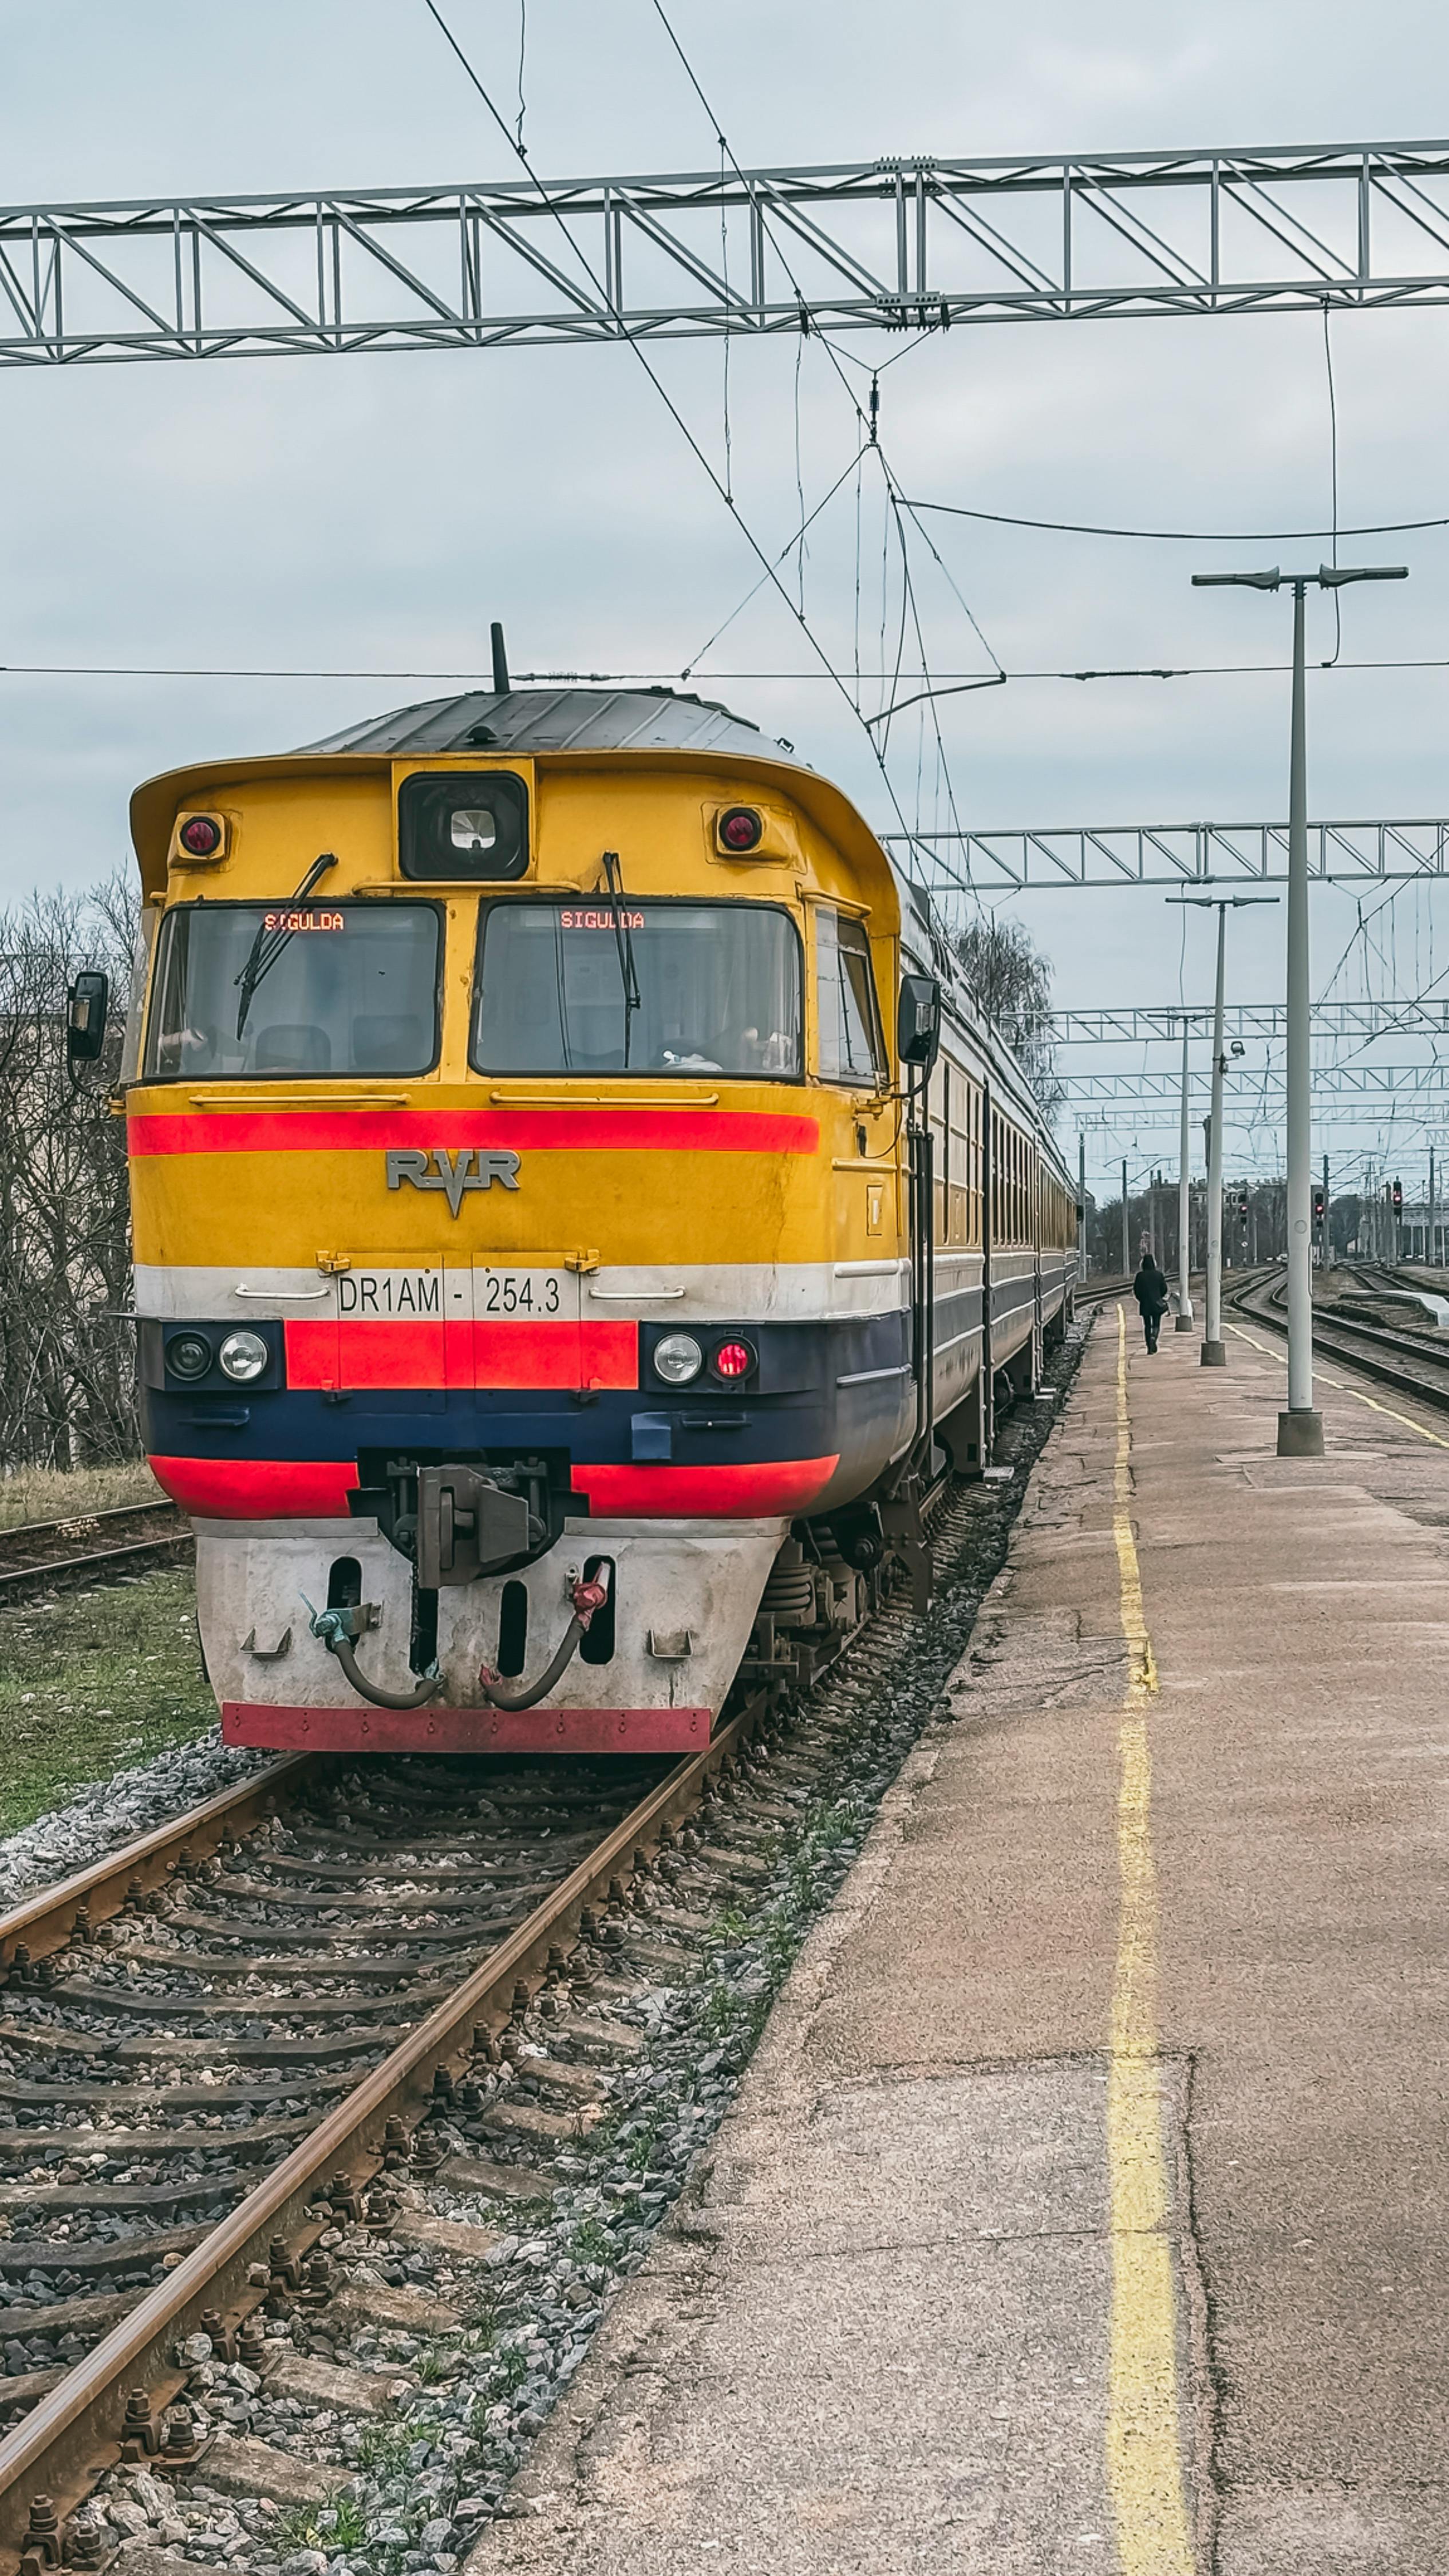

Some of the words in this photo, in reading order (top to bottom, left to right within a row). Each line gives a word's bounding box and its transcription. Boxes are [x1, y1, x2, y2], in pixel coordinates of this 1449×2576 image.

[560, 911, 645, 929] SIGULDA
[387, 1149, 520, 1219] RVR
[339, 1277, 439, 1312] DR1AM
[486, 1277, 559, 1312] 254.3
